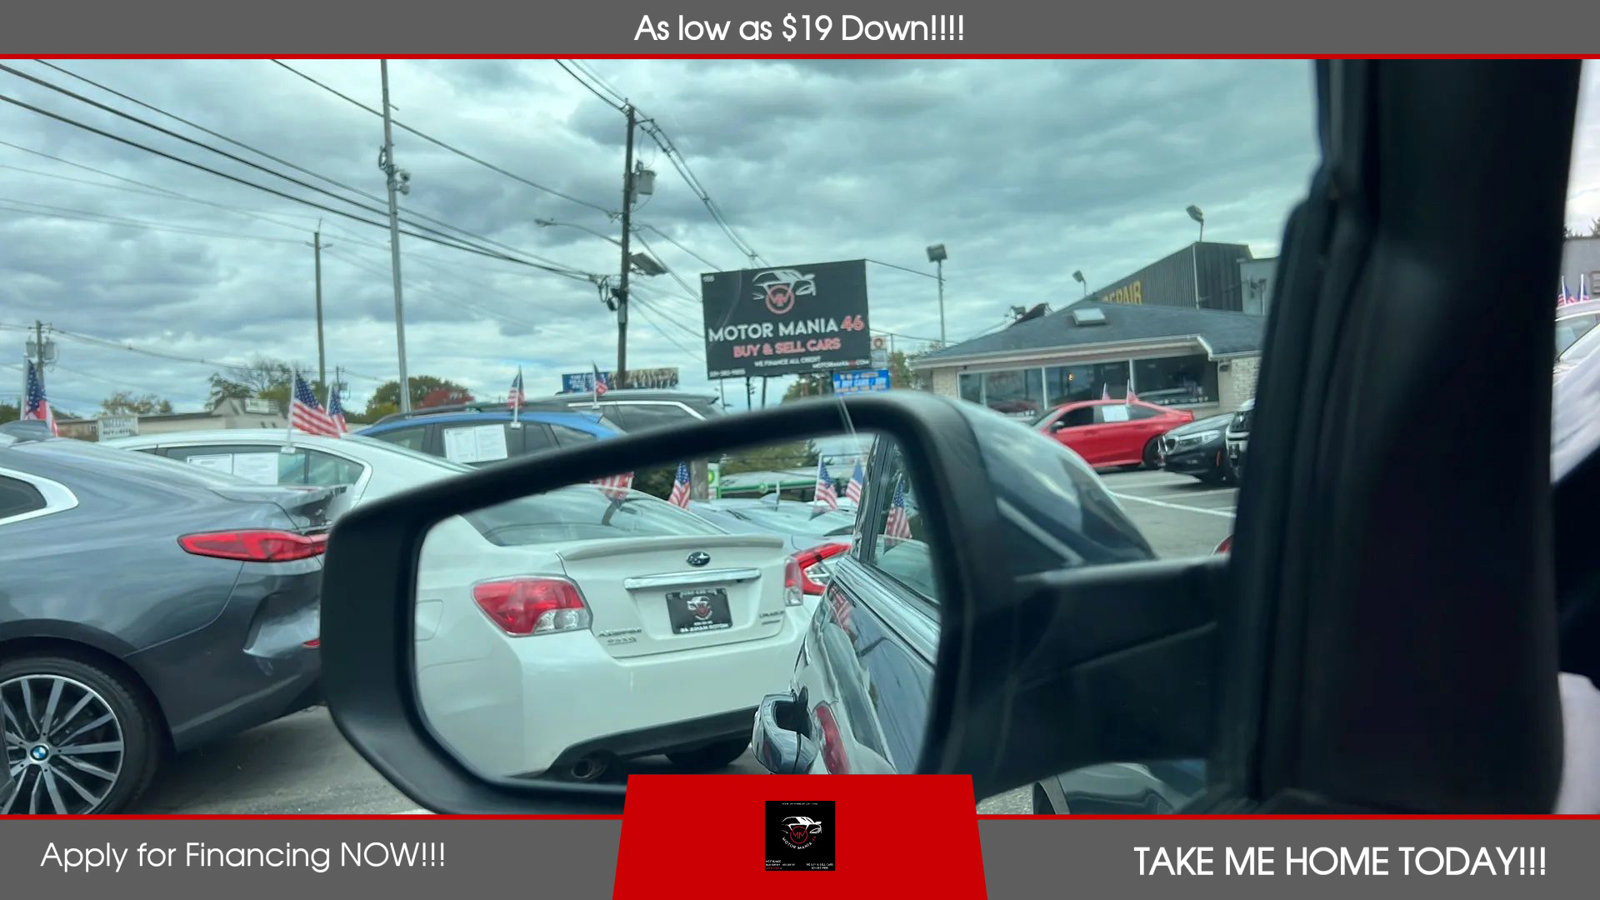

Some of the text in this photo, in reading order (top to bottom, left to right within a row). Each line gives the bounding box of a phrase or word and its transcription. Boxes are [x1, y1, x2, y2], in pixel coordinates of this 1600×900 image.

[708, 315, 864, 342] MOTOR MANIA 46
[733, 338, 841, 358] BUY & SELL CARS
